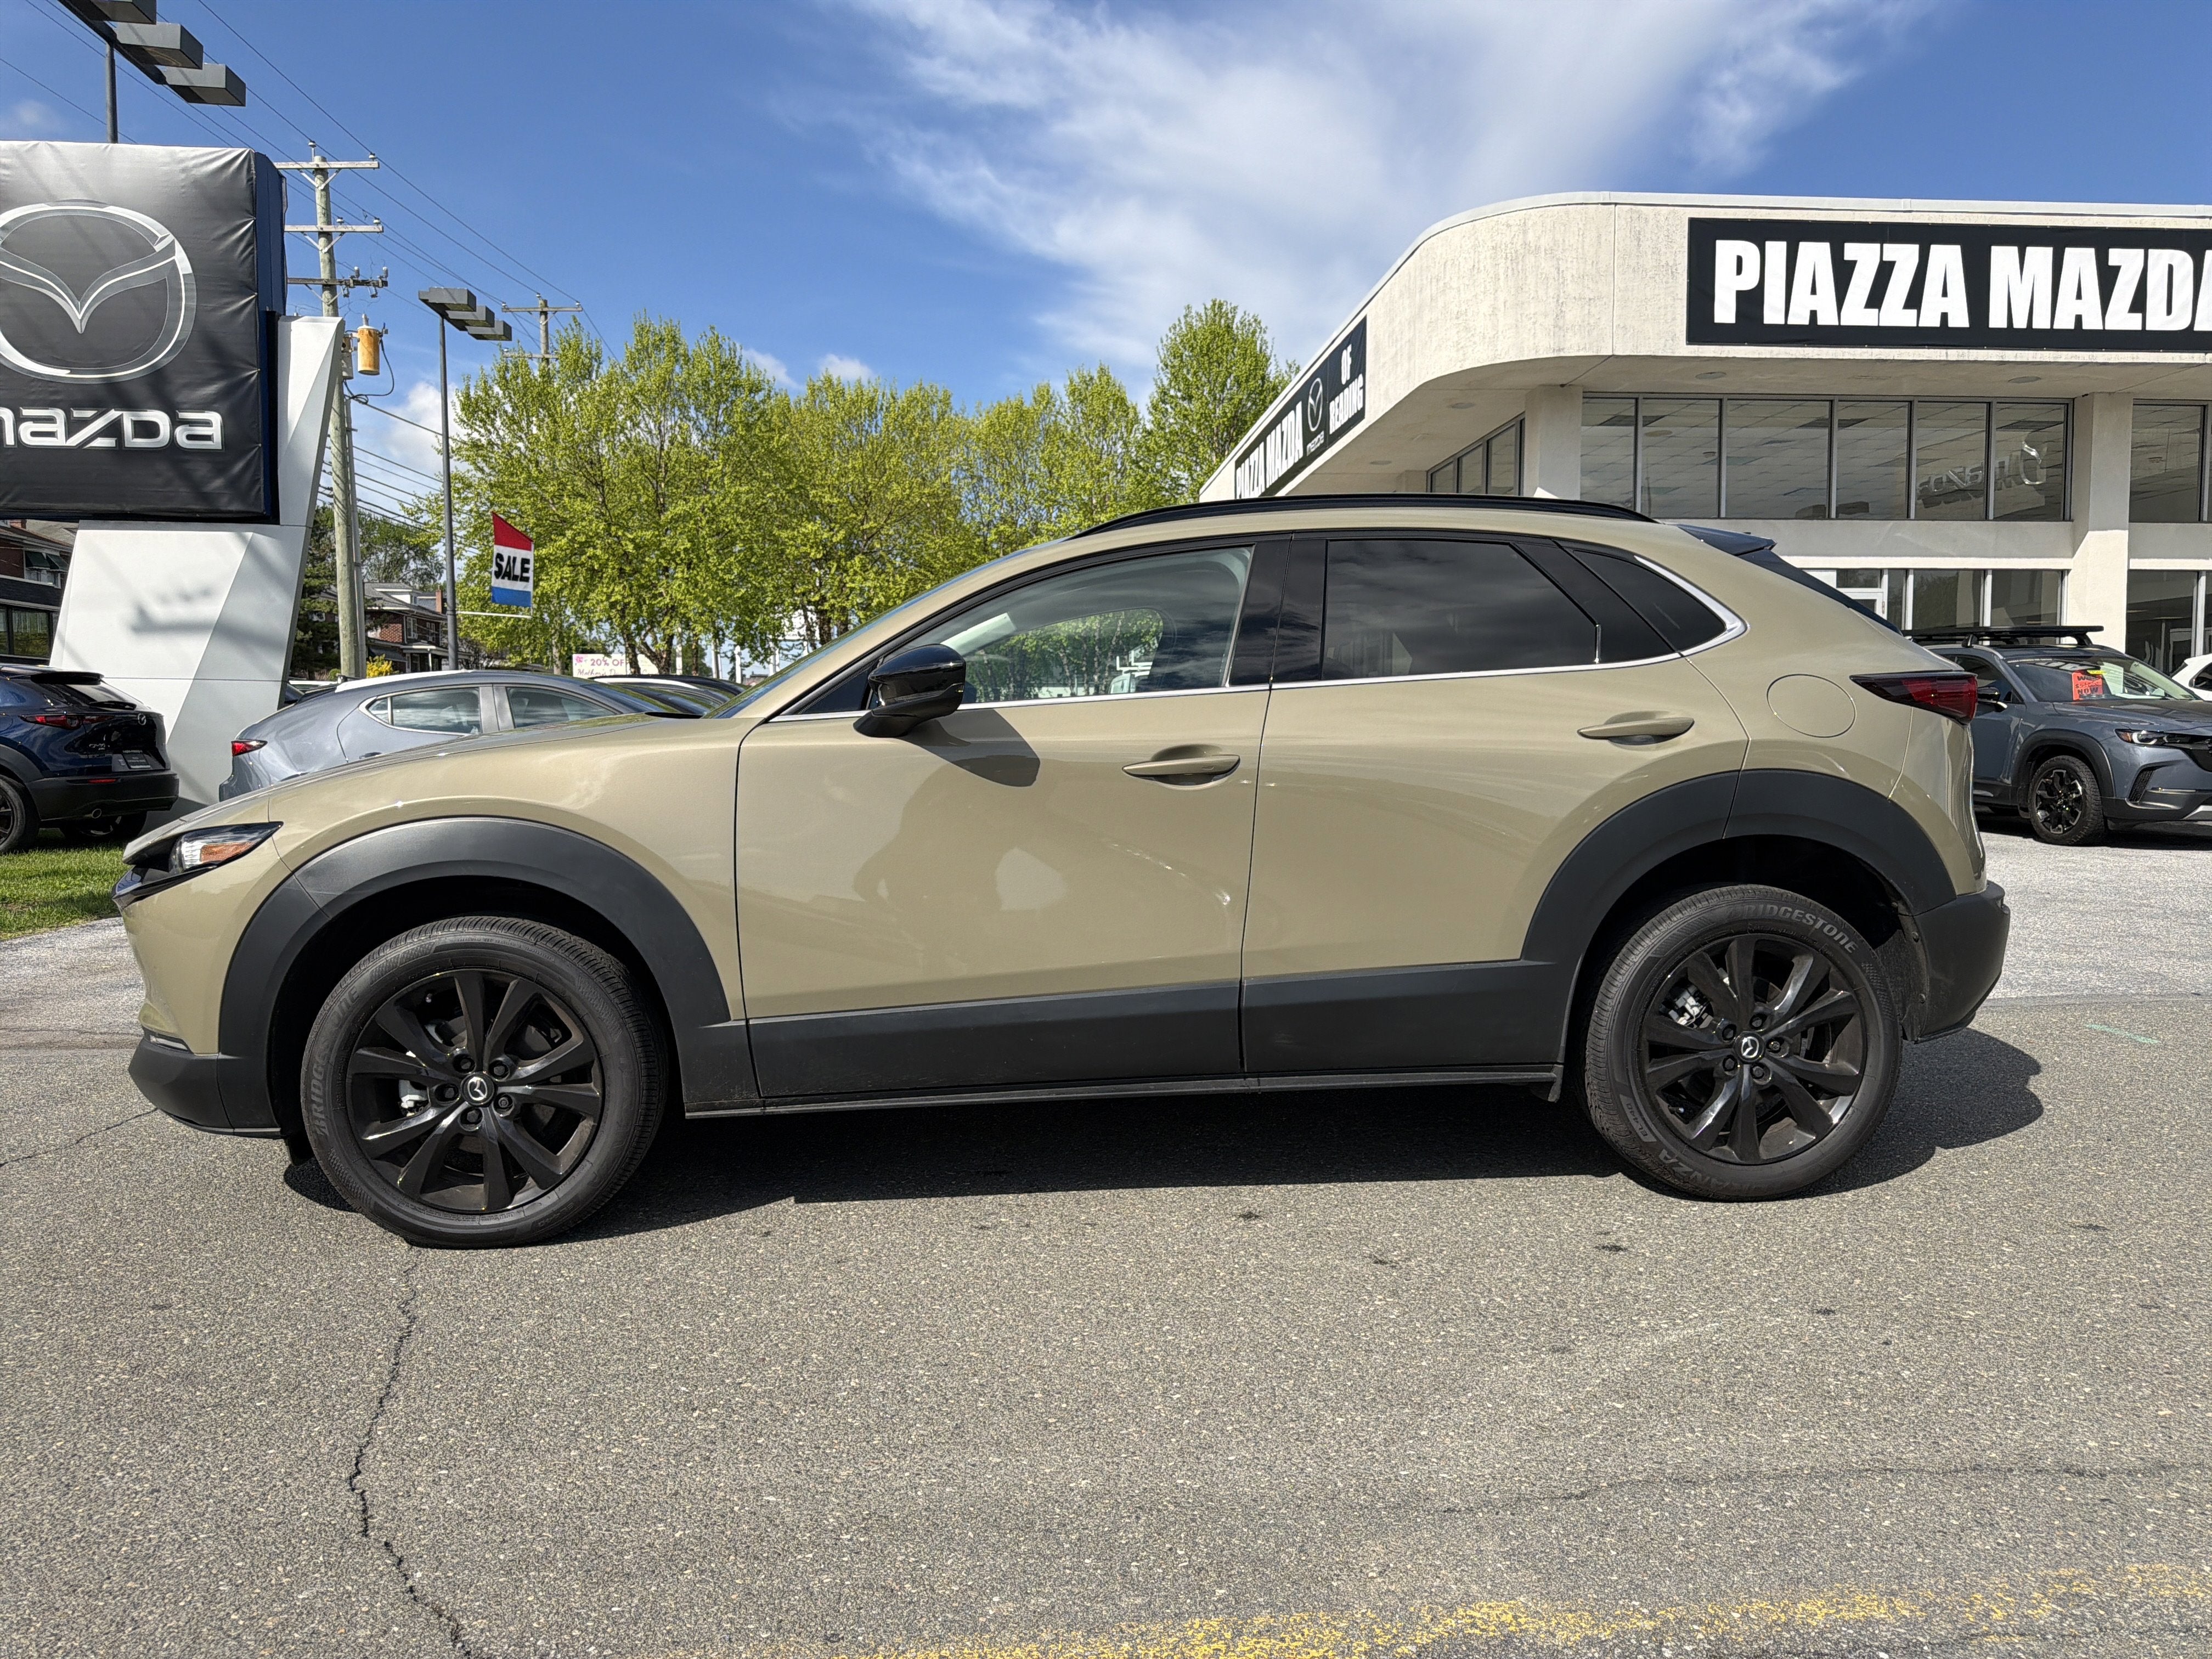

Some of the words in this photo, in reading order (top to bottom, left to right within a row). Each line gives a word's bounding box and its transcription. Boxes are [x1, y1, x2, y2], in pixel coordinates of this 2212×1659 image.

[1714, 240, 1970, 328] PIAZZA
[1341, 343, 1352, 385] OF
[1329, 374, 1364, 435] READING
[1235, 441, 1265, 499] PIAZZA
[1266, 400, 1304, 488] MAZDA
[494, 552, 531, 583] SALE
